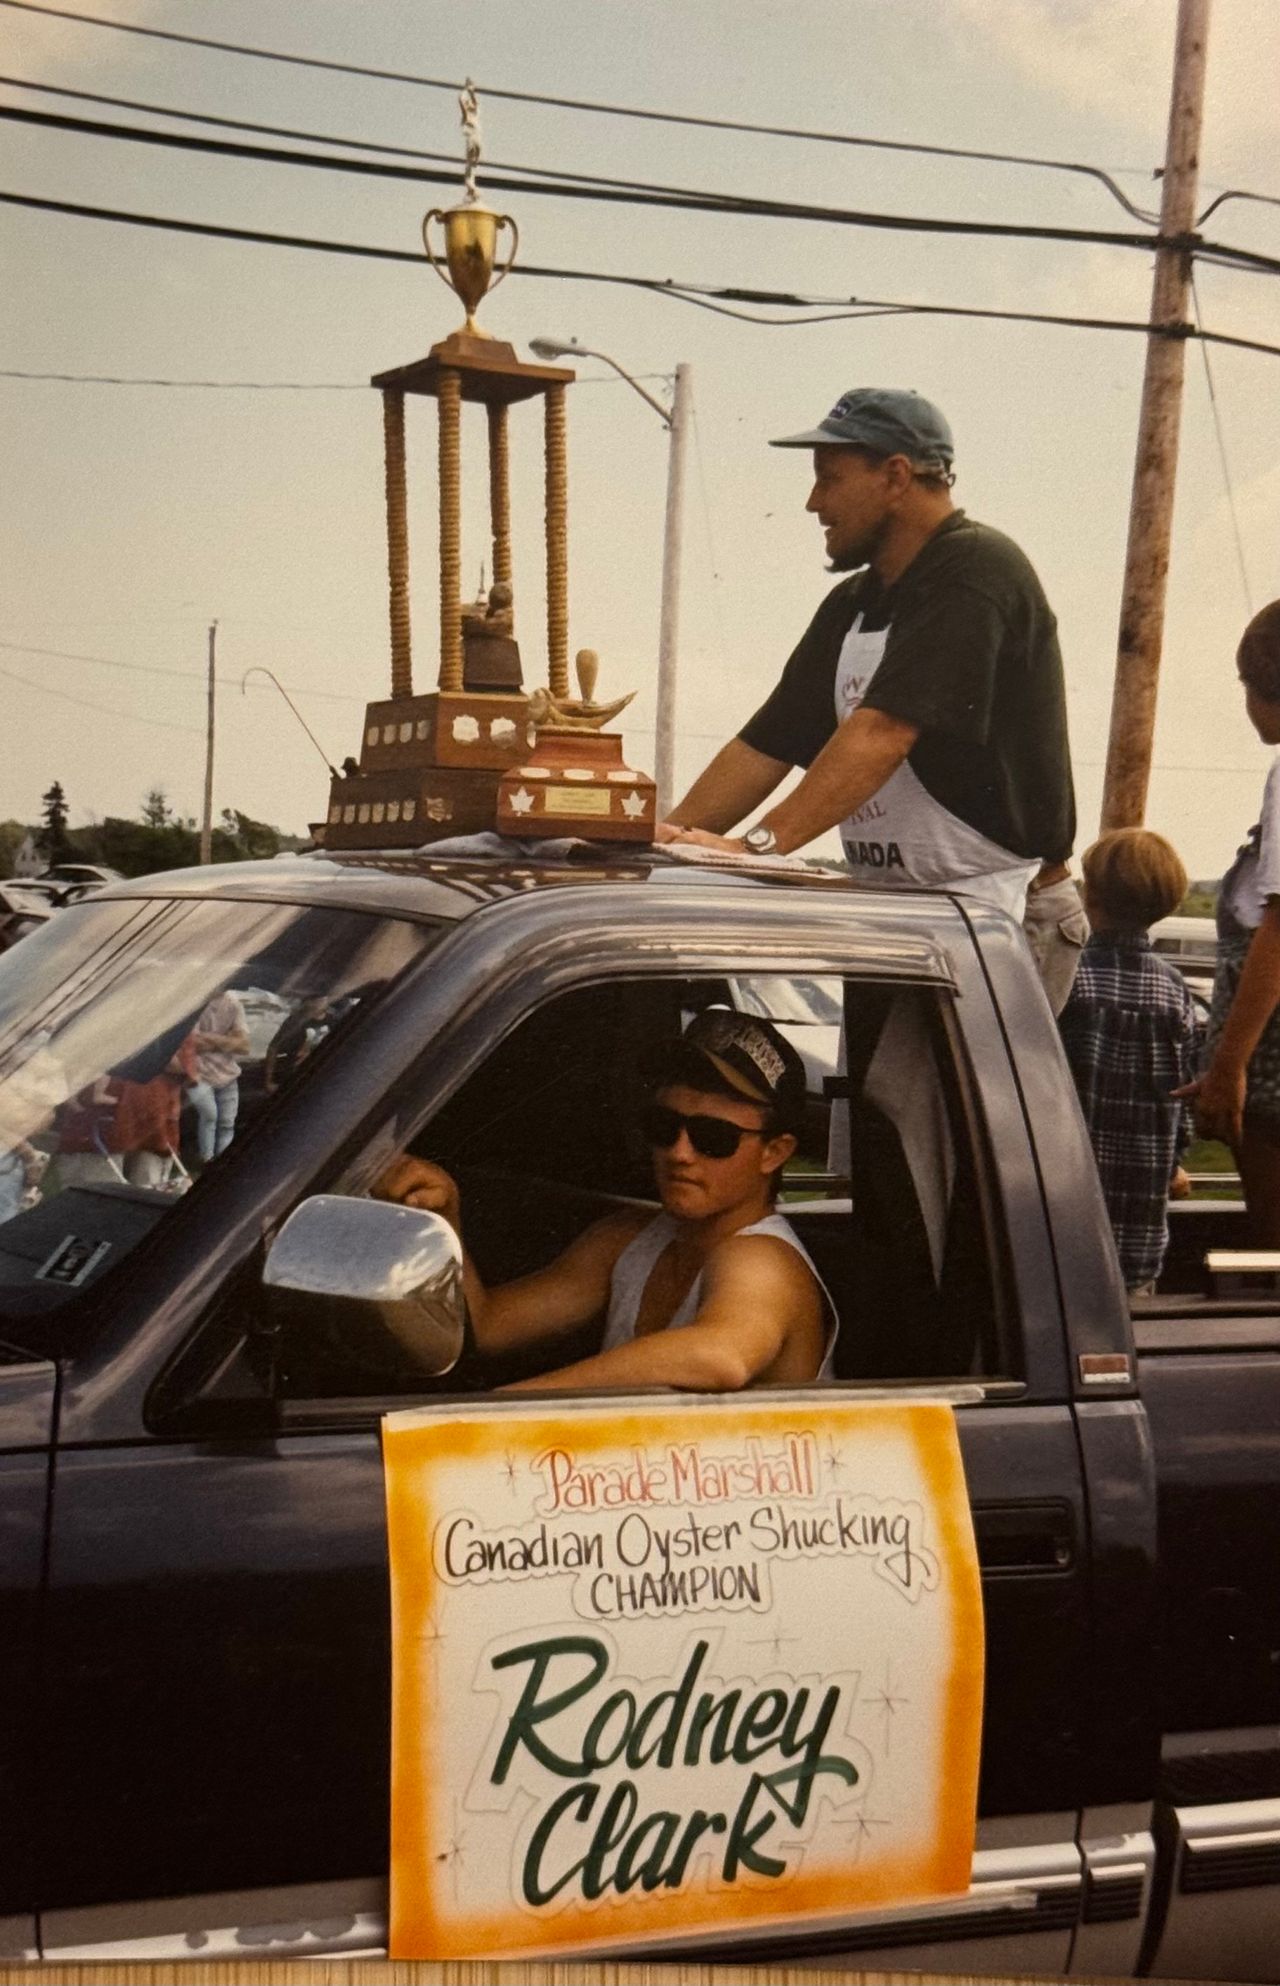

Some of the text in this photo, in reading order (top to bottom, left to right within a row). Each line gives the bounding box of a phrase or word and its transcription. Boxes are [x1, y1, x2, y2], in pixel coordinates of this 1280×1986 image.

[538, 1438, 814, 1511] Parade Marshall
[444, 1500, 931, 1588] Canadian Oyster Shucking
[590, 1562, 761, 1615] CHAMPION
[491, 1635, 860, 1829] Rodney
[522, 1772, 787, 1907] Clark
